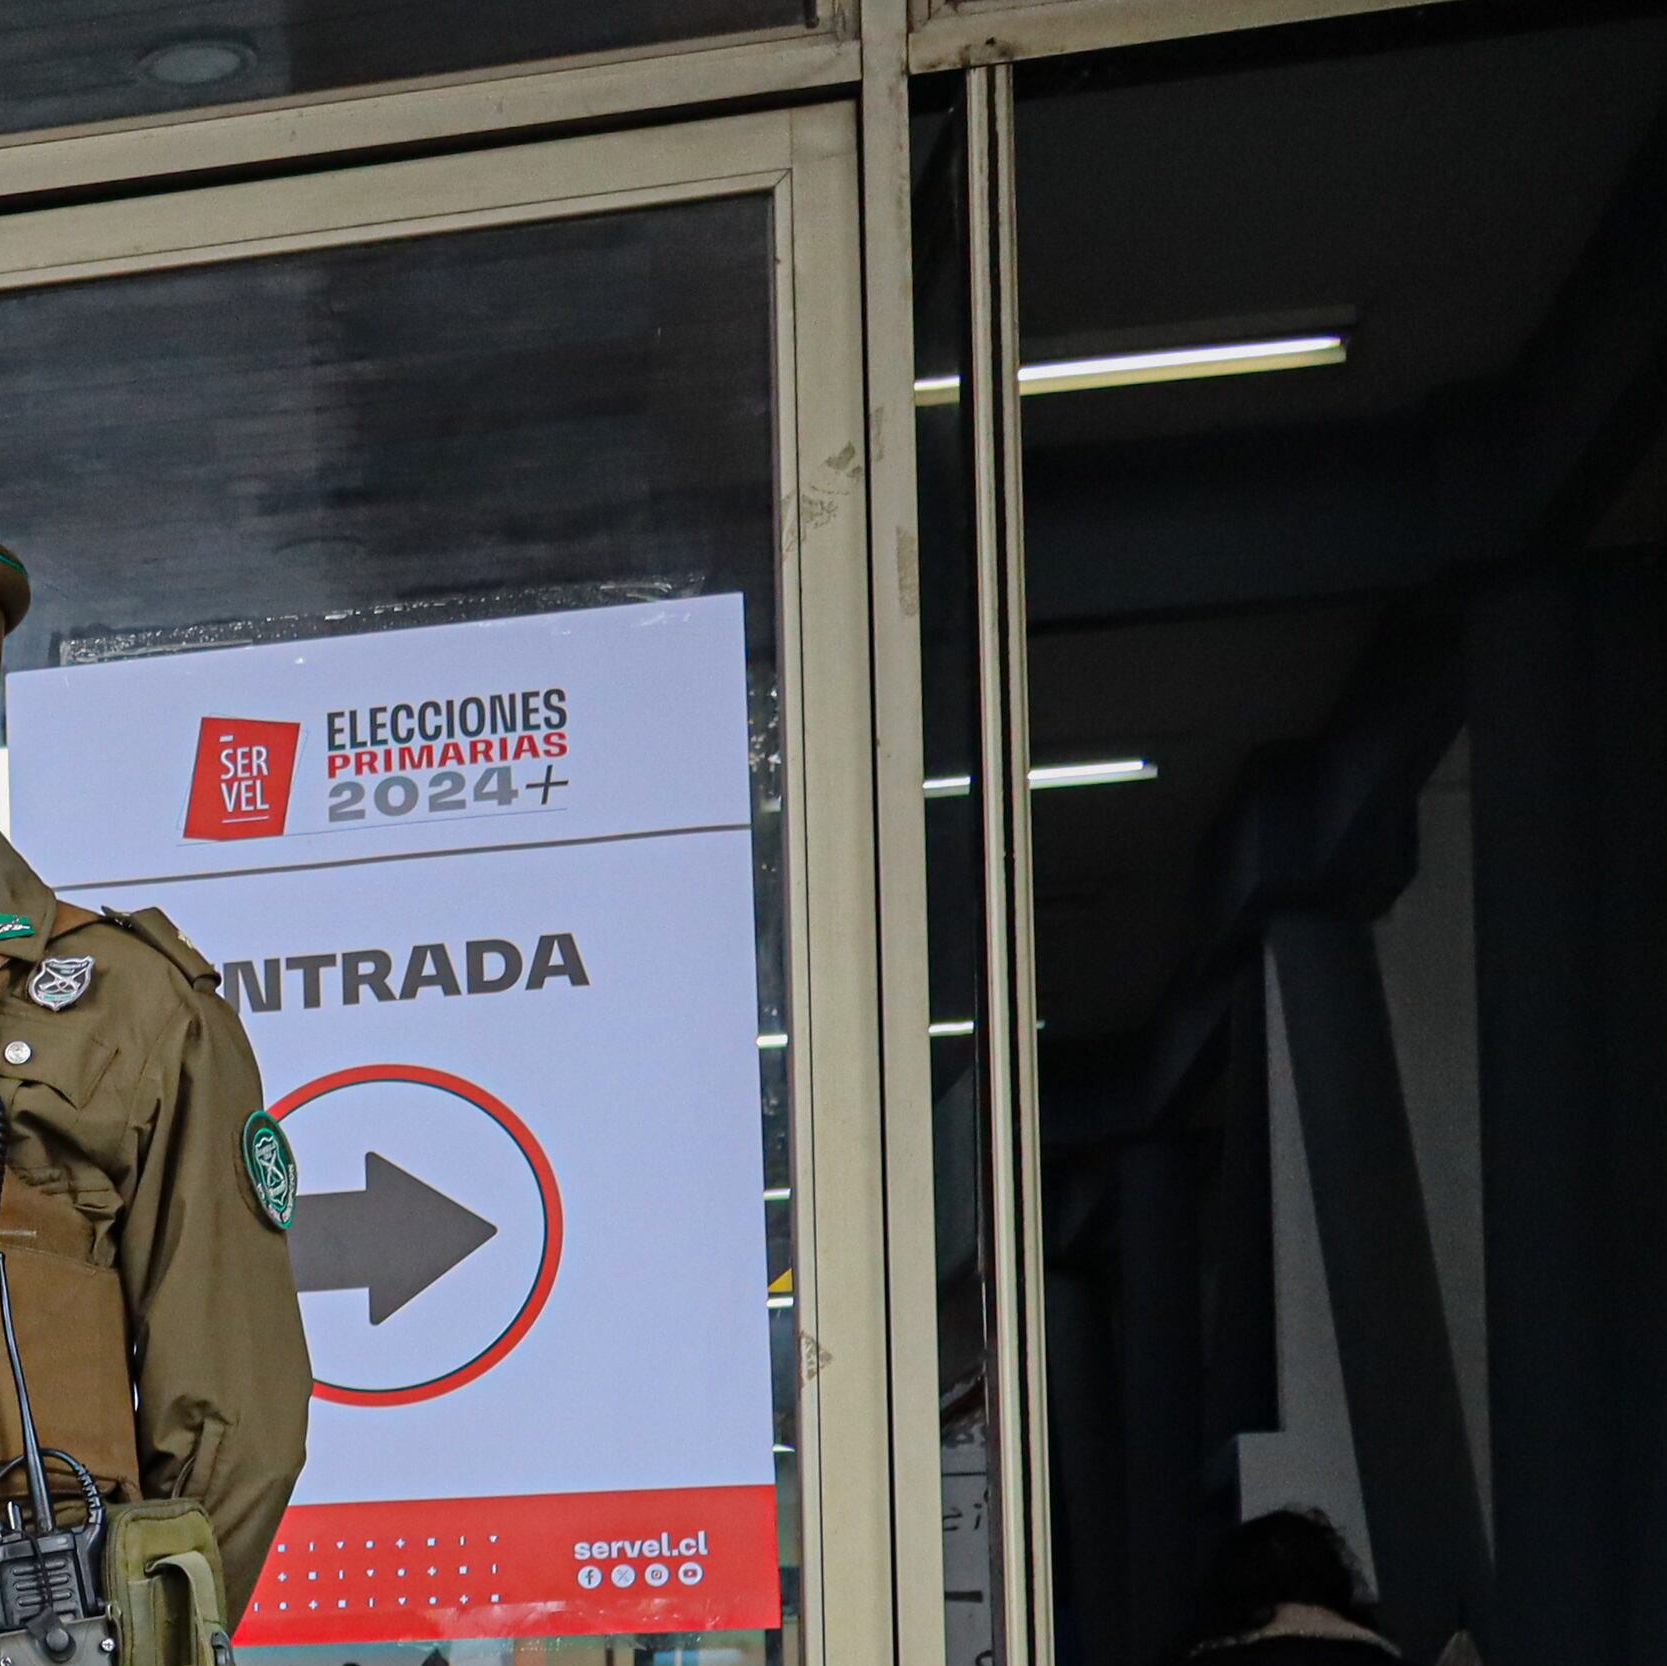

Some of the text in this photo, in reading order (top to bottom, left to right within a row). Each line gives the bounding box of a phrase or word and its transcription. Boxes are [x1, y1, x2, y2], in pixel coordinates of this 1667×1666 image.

[327, 688, 567, 751] ELECCIONES
[220, 746, 269, 779] SER
[327, 731, 568, 779] PRIMARIAS
[220, 779, 269, 813] VEL
[223, 932, 591, 1013] NTRADA
[574, 1530, 708, 1560] servel.cl
